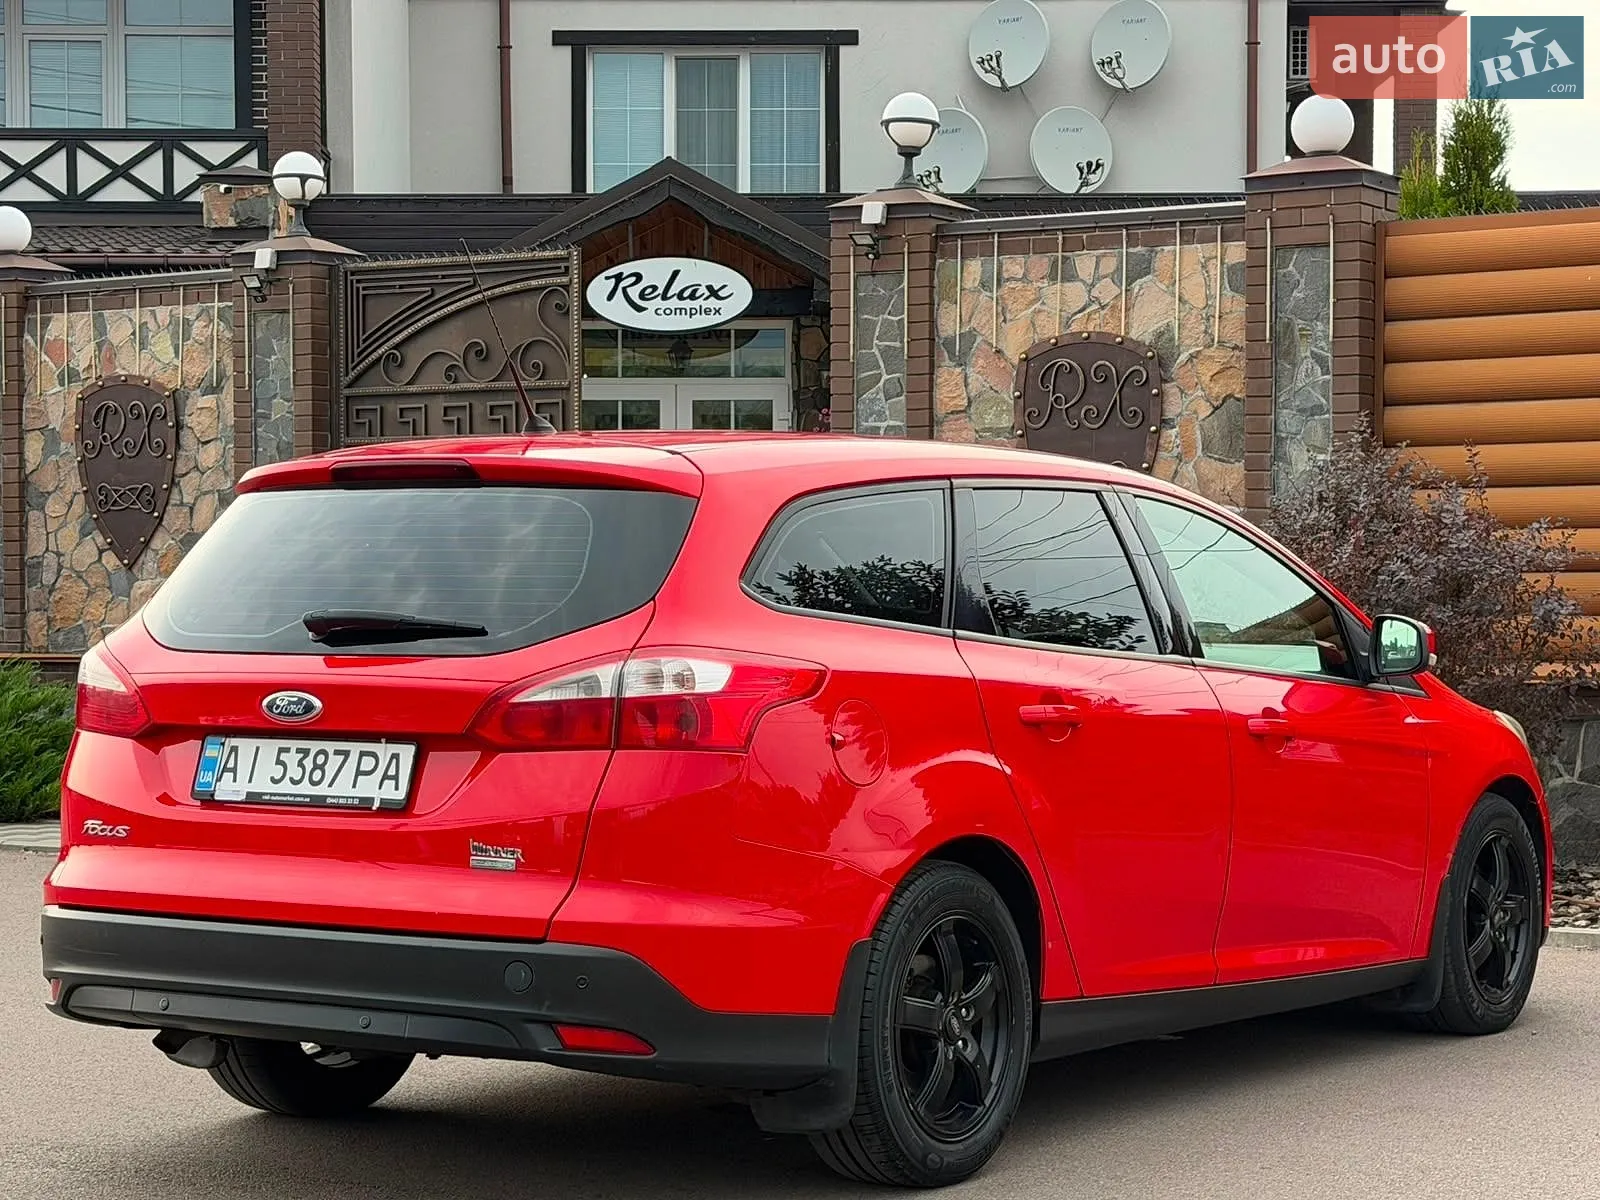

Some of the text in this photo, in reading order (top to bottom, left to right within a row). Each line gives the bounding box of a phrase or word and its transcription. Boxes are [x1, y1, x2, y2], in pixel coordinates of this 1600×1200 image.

[604, 269, 734, 313] Relax
[654, 305, 722, 318] complex
[273, 696, 306, 714] Ford
[200, 770, 213, 784] UA
[269, 747, 351, 788] 5387
[352, 751, 401, 791] PA
[469, 838, 526, 863] WINNER
